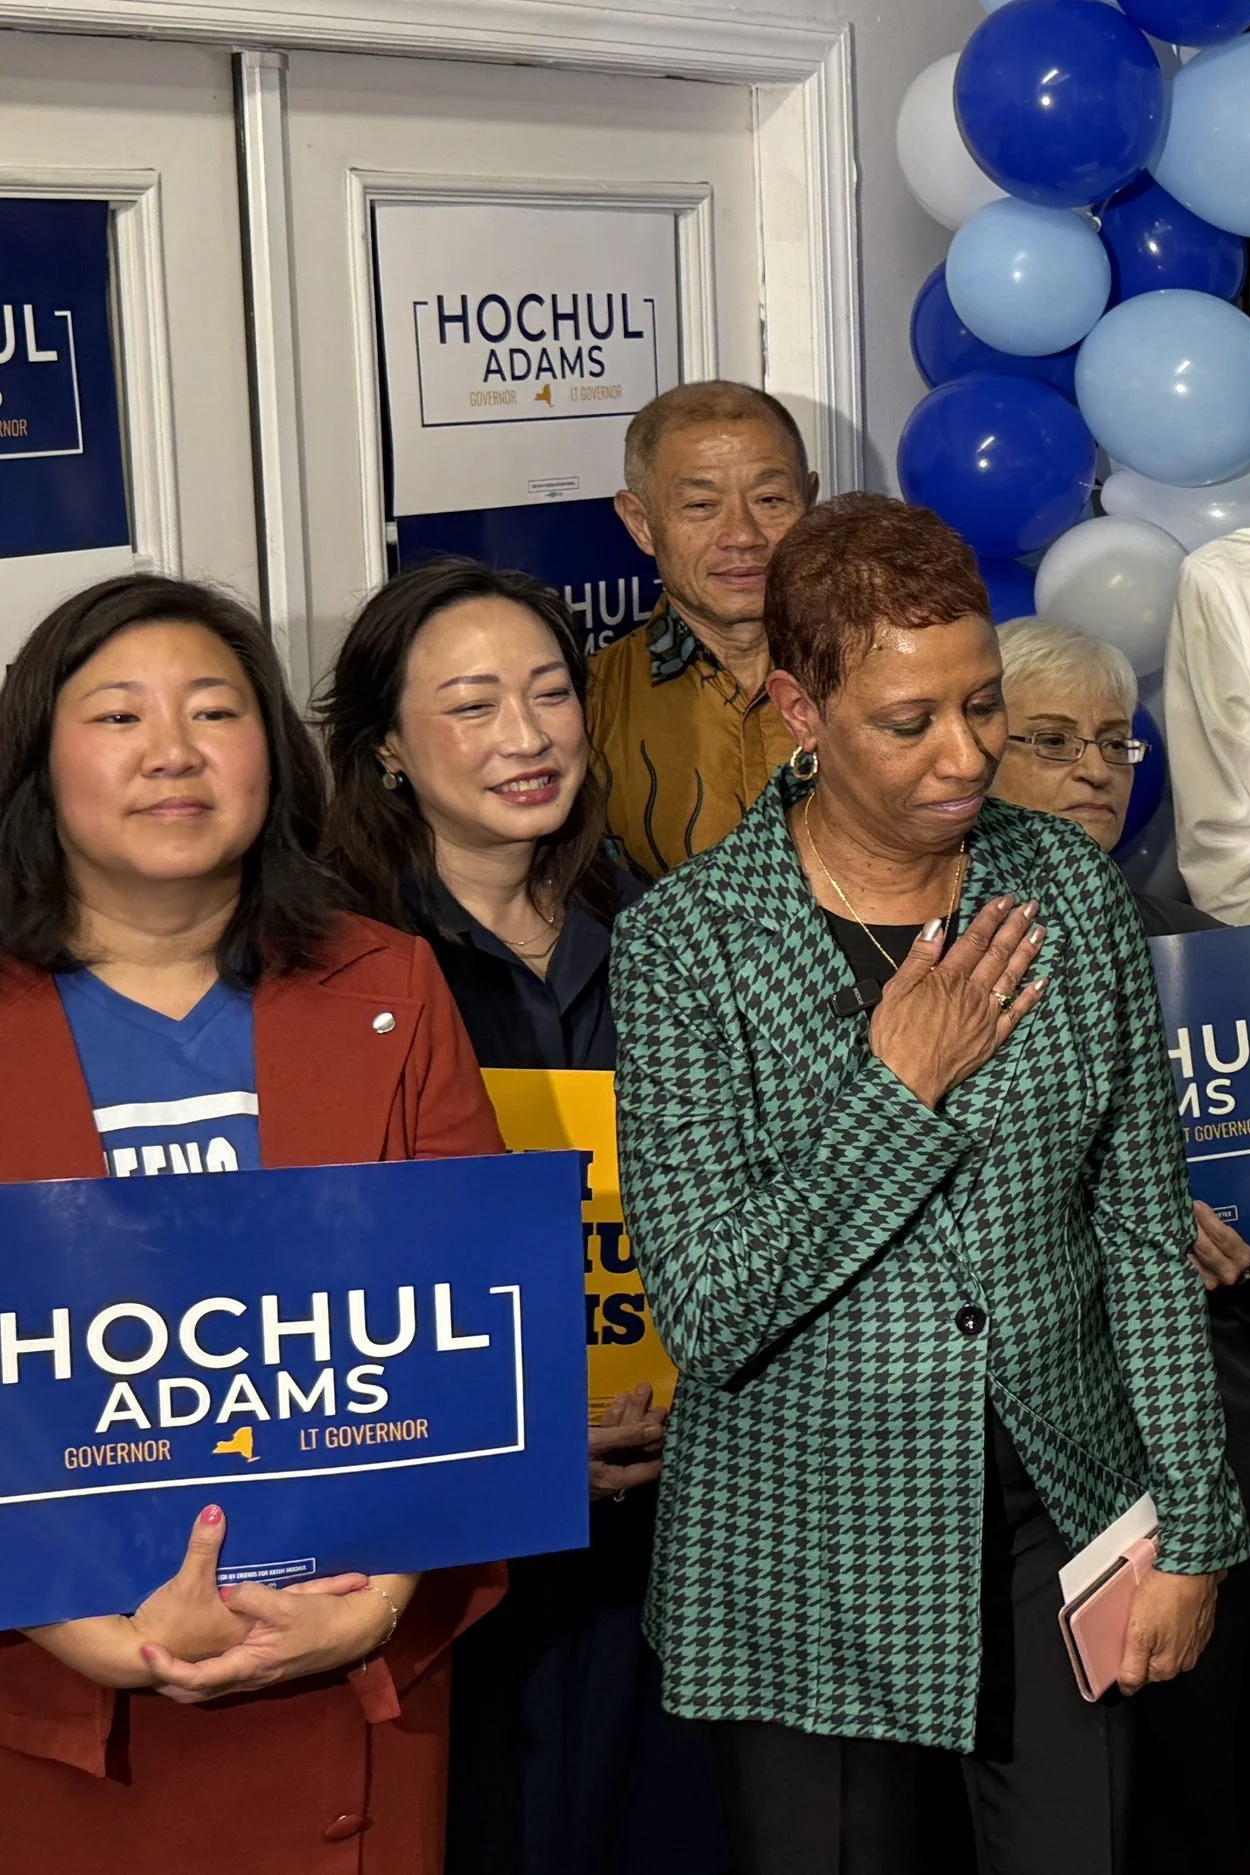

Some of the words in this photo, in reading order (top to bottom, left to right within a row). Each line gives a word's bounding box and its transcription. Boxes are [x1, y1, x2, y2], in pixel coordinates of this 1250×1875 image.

[436, 293, 644, 344] HOCHUL
[483, 345, 606, 383] ADAMS
[469, 389, 518, 407] GOVERNOR
[570, 387, 580, 401] LT
[580, 384, 623, 401] GOVERNOR
[564, 576, 653, 629] HUL
[0, 1283, 490, 1384] HOCHUL
[95, 1364, 389, 1433] ADAMS
[300, 1429, 319, 1451] LT
[325, 1419, 429, 1448] GOVERNOR
[64, 1440, 172, 1470] GOVERNOR
